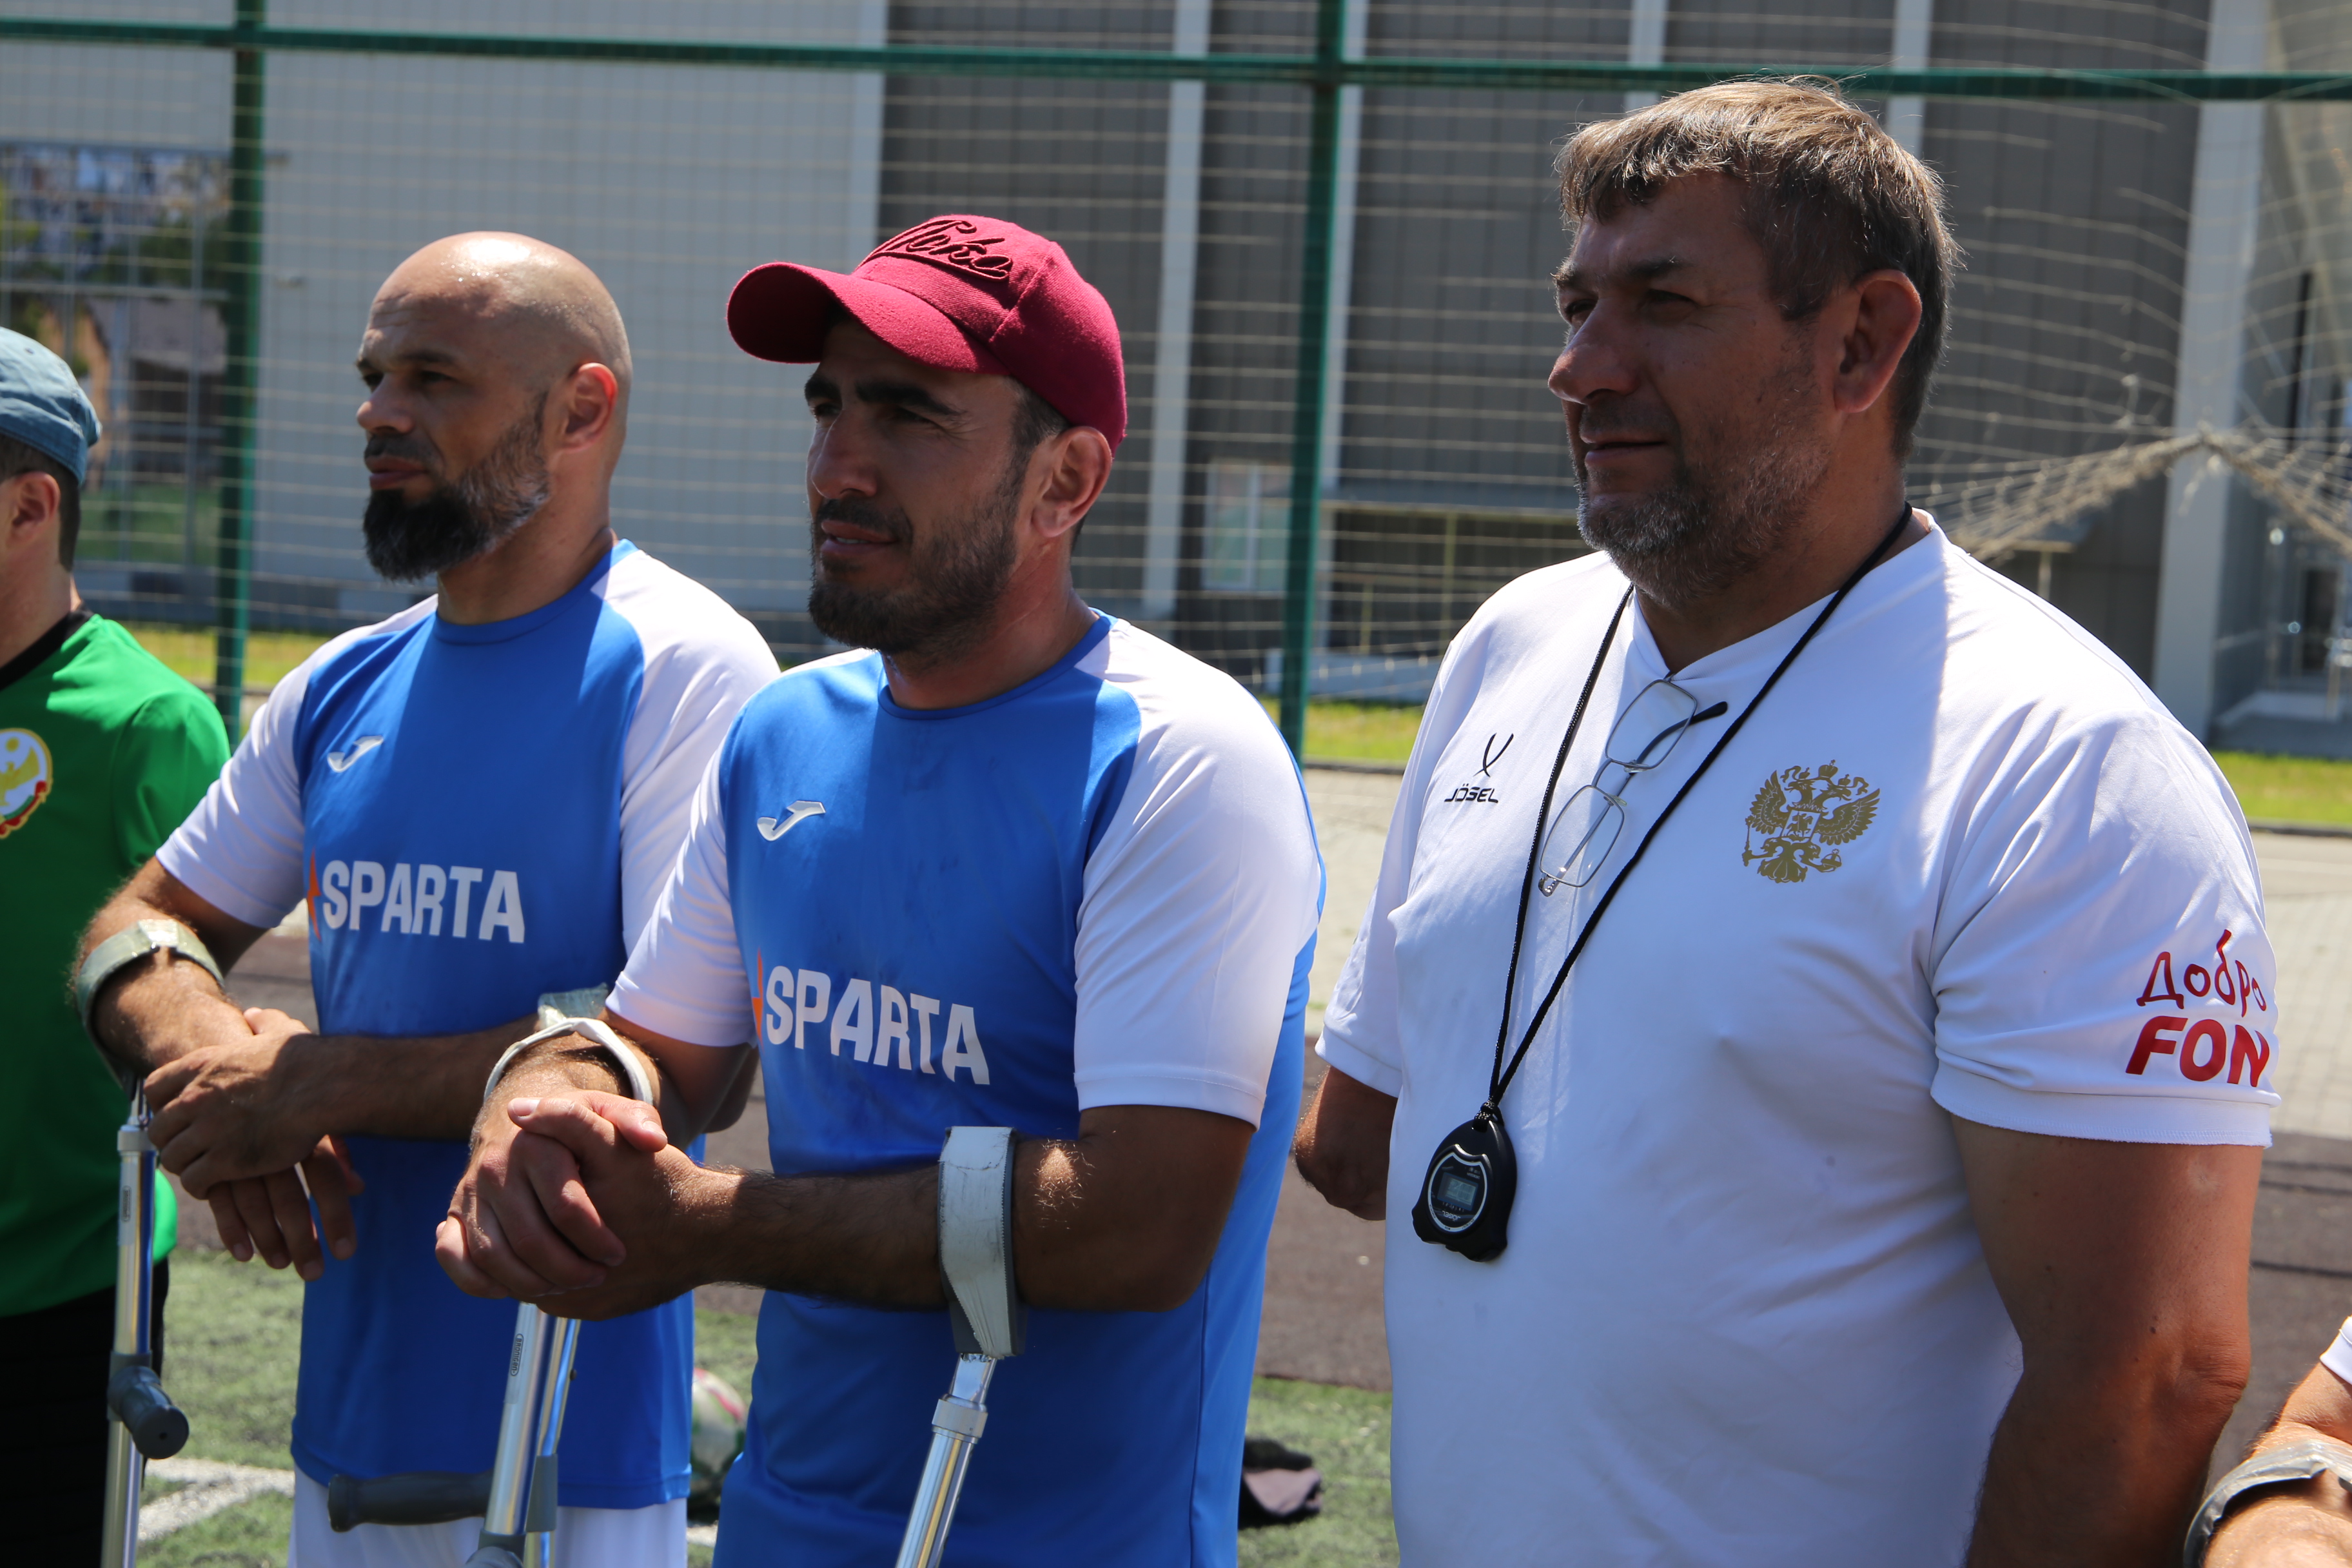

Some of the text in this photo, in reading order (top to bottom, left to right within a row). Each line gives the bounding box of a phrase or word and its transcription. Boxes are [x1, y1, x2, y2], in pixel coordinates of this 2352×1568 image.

[322, 859, 525, 943] SPARTA
[2135, 928, 2267, 1018] Добро
[765, 965, 990, 1086] SPARTA
[2125, 1015, 2270, 1088] FON
